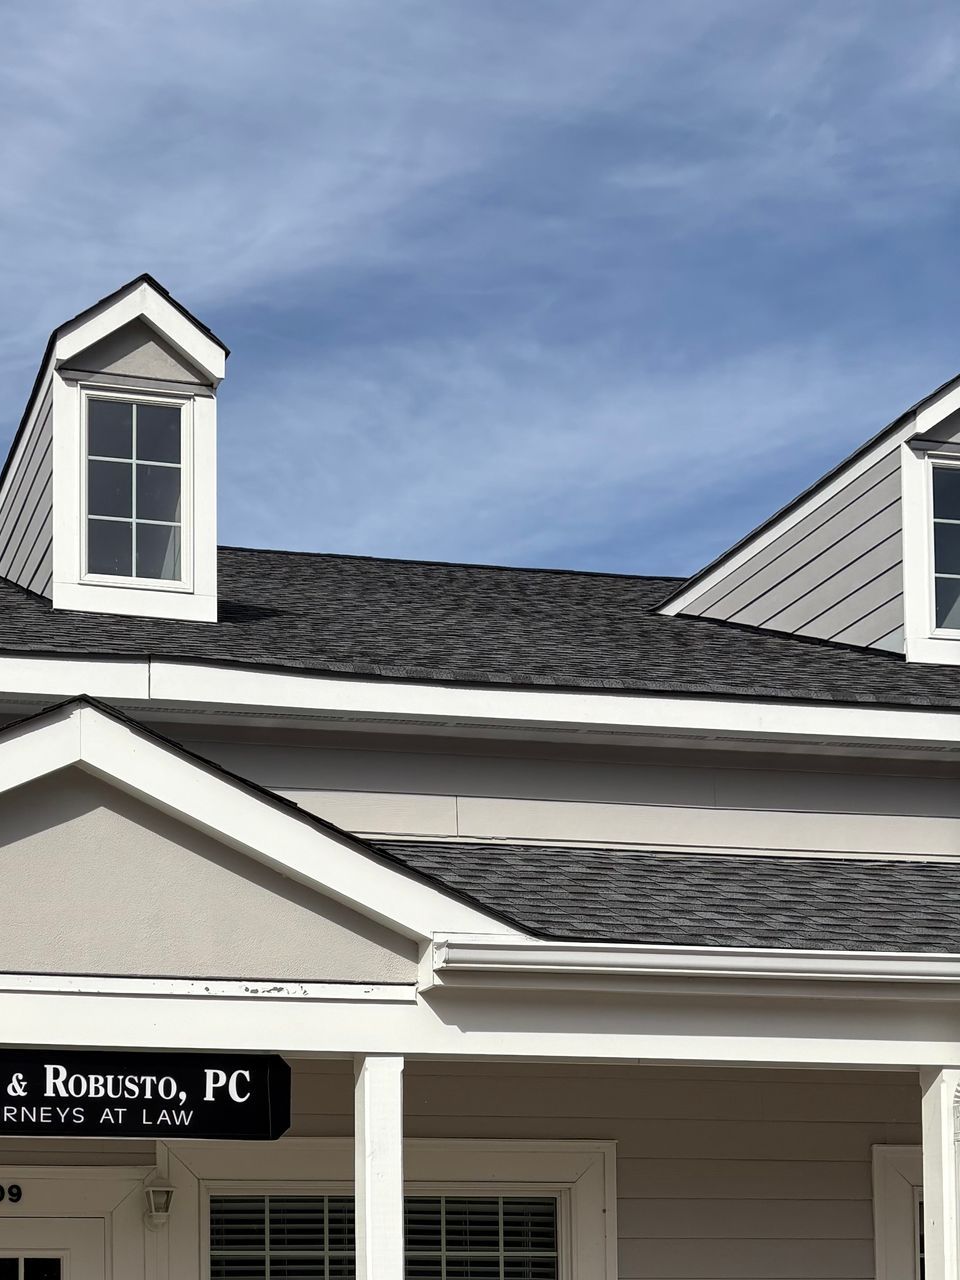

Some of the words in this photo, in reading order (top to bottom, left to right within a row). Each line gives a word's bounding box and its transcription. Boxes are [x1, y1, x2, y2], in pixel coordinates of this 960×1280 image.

[6, 1072, 28, 1097] &
[43, 1064, 187, 1106] ROBUSTO,
[203, 1068, 252, 1103] PC
[99, 1107, 128, 1124] AT
[142, 1108, 194, 1126] LAW
